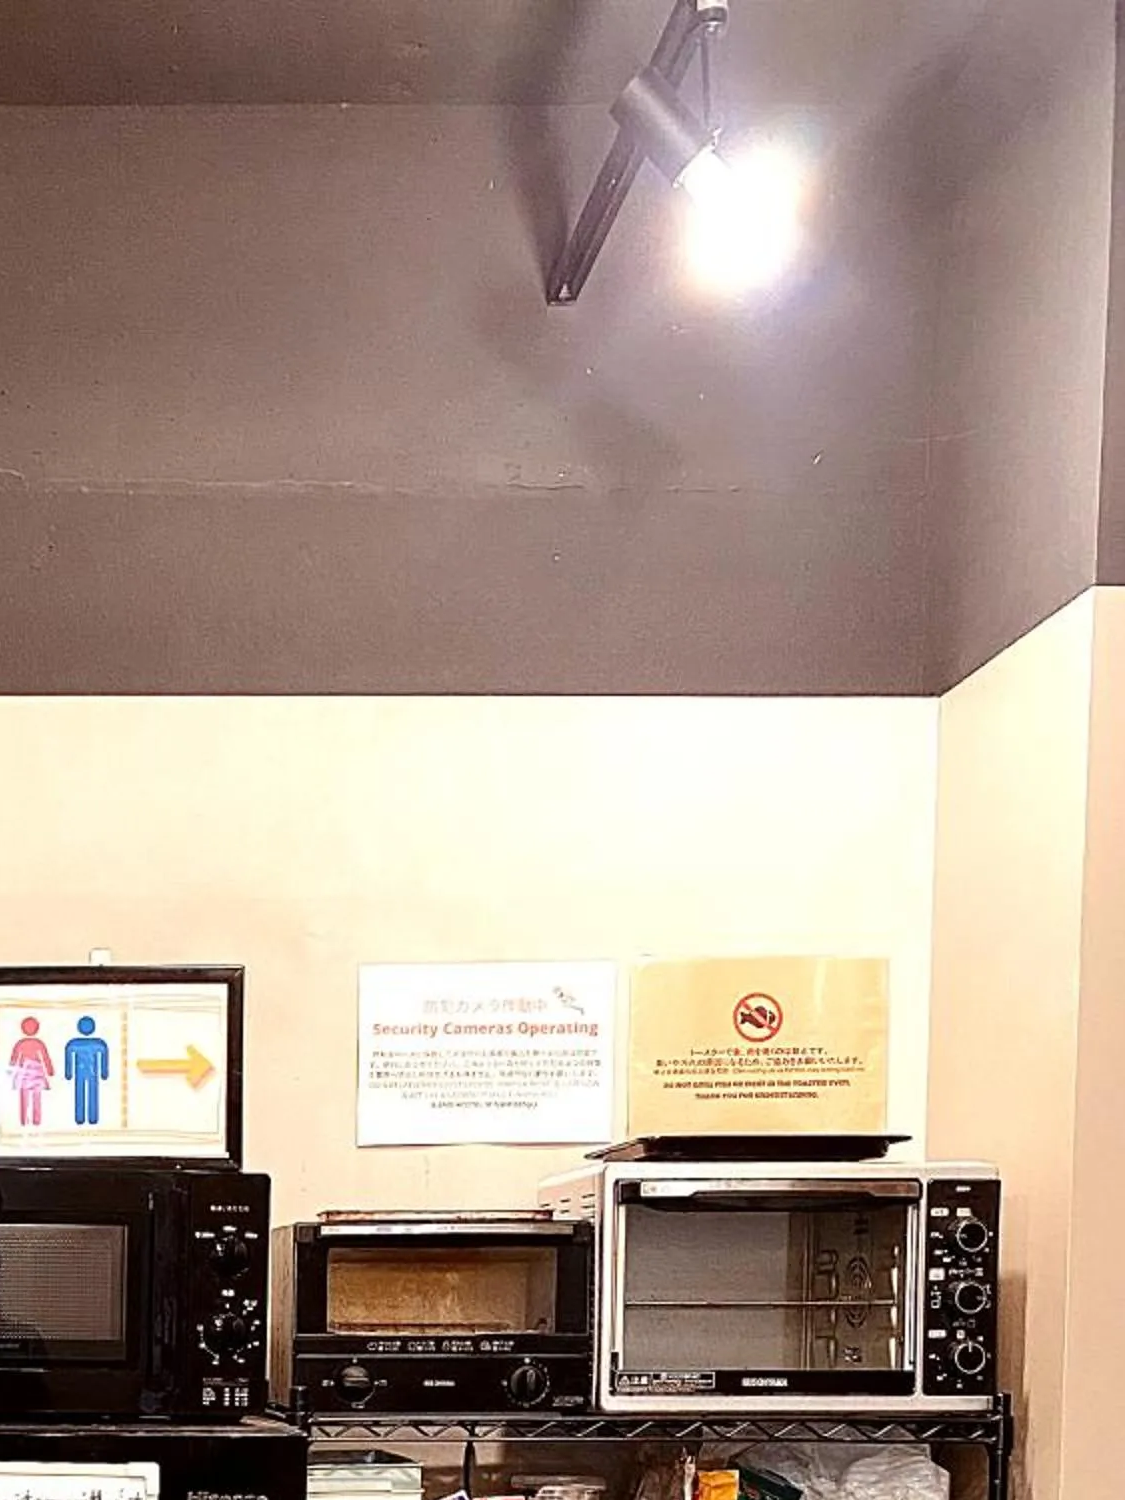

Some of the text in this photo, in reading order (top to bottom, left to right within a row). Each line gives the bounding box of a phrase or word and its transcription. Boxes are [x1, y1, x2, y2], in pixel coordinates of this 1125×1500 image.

[372, 1021, 599, 1038] Security Cameras Operating
